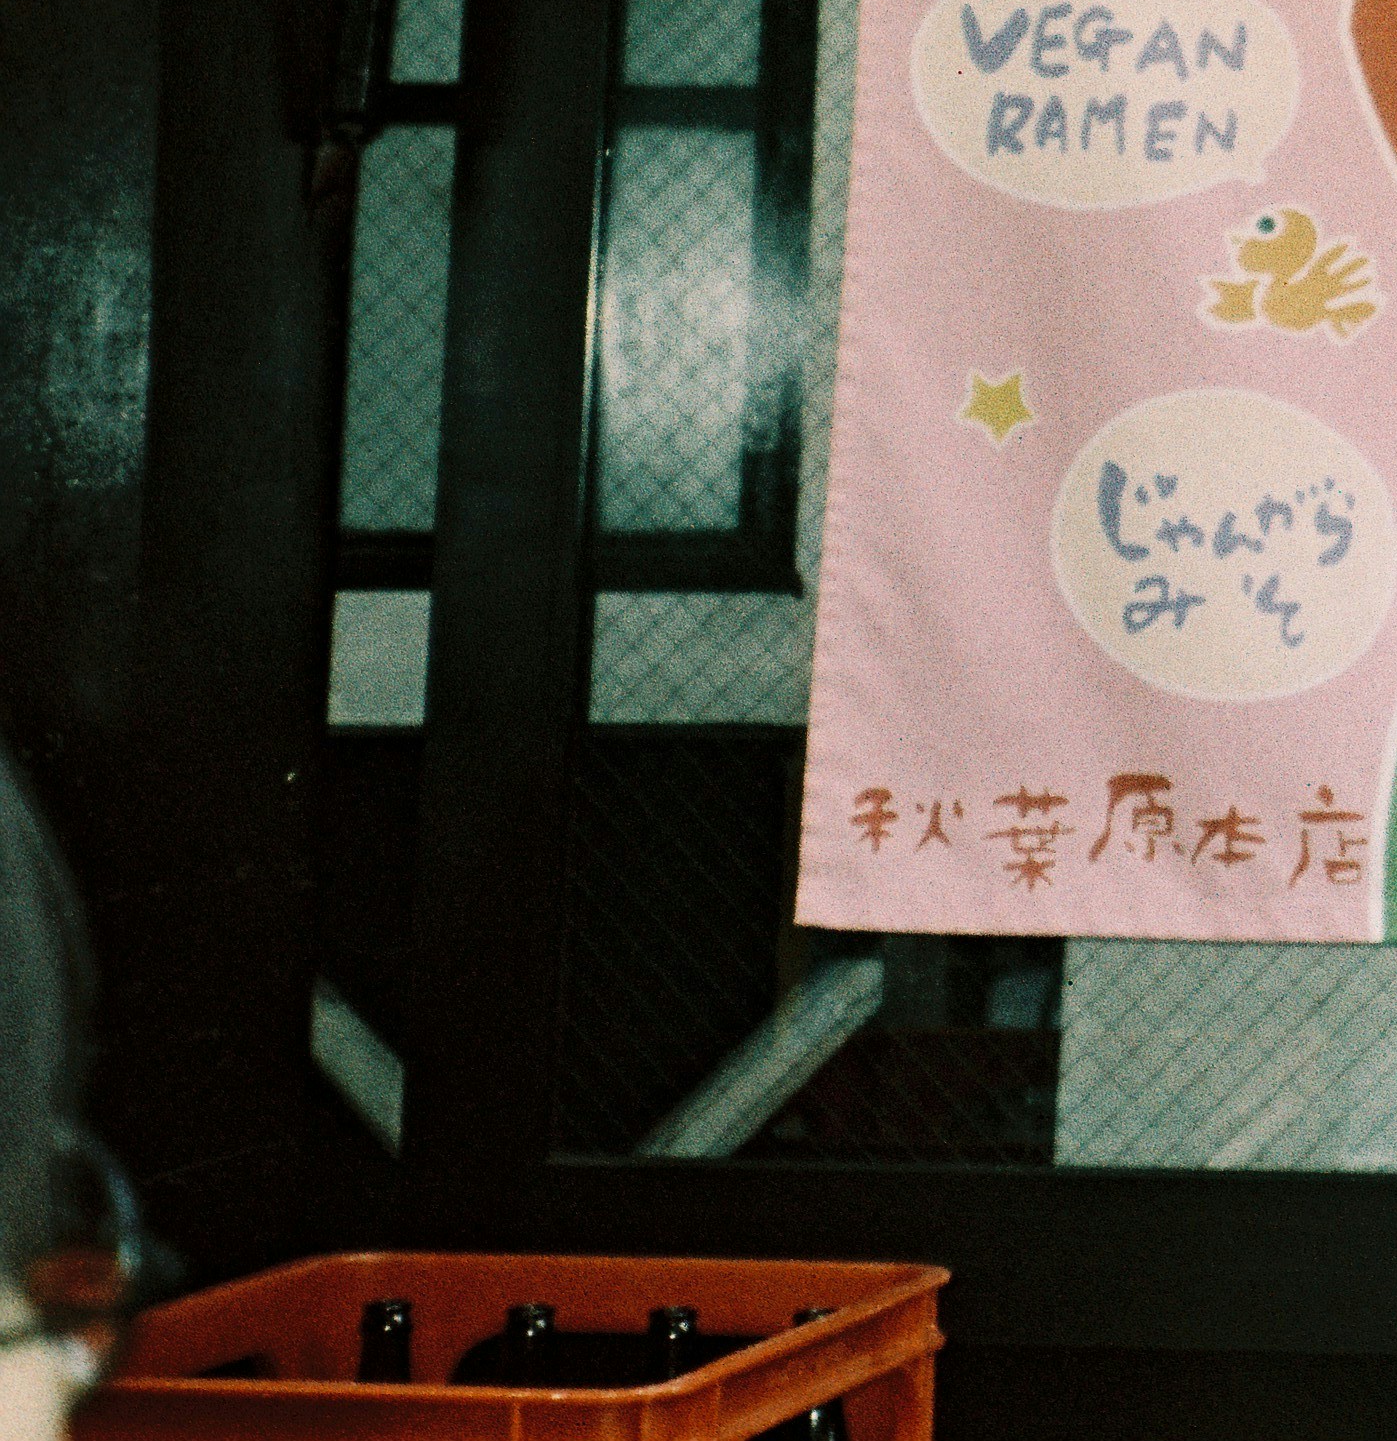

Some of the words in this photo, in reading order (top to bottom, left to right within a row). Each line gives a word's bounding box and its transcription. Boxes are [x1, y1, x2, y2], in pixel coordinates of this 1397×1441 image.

[959, 0, 1248, 80] VEGAN
[986, 94, 1239, 161] RAMEN
[1098, 459, 1355, 563] じゃんがら
[1121, 573, 1306, 647] みそ
[850, 772, 1369, 891] 秋葉原本店
